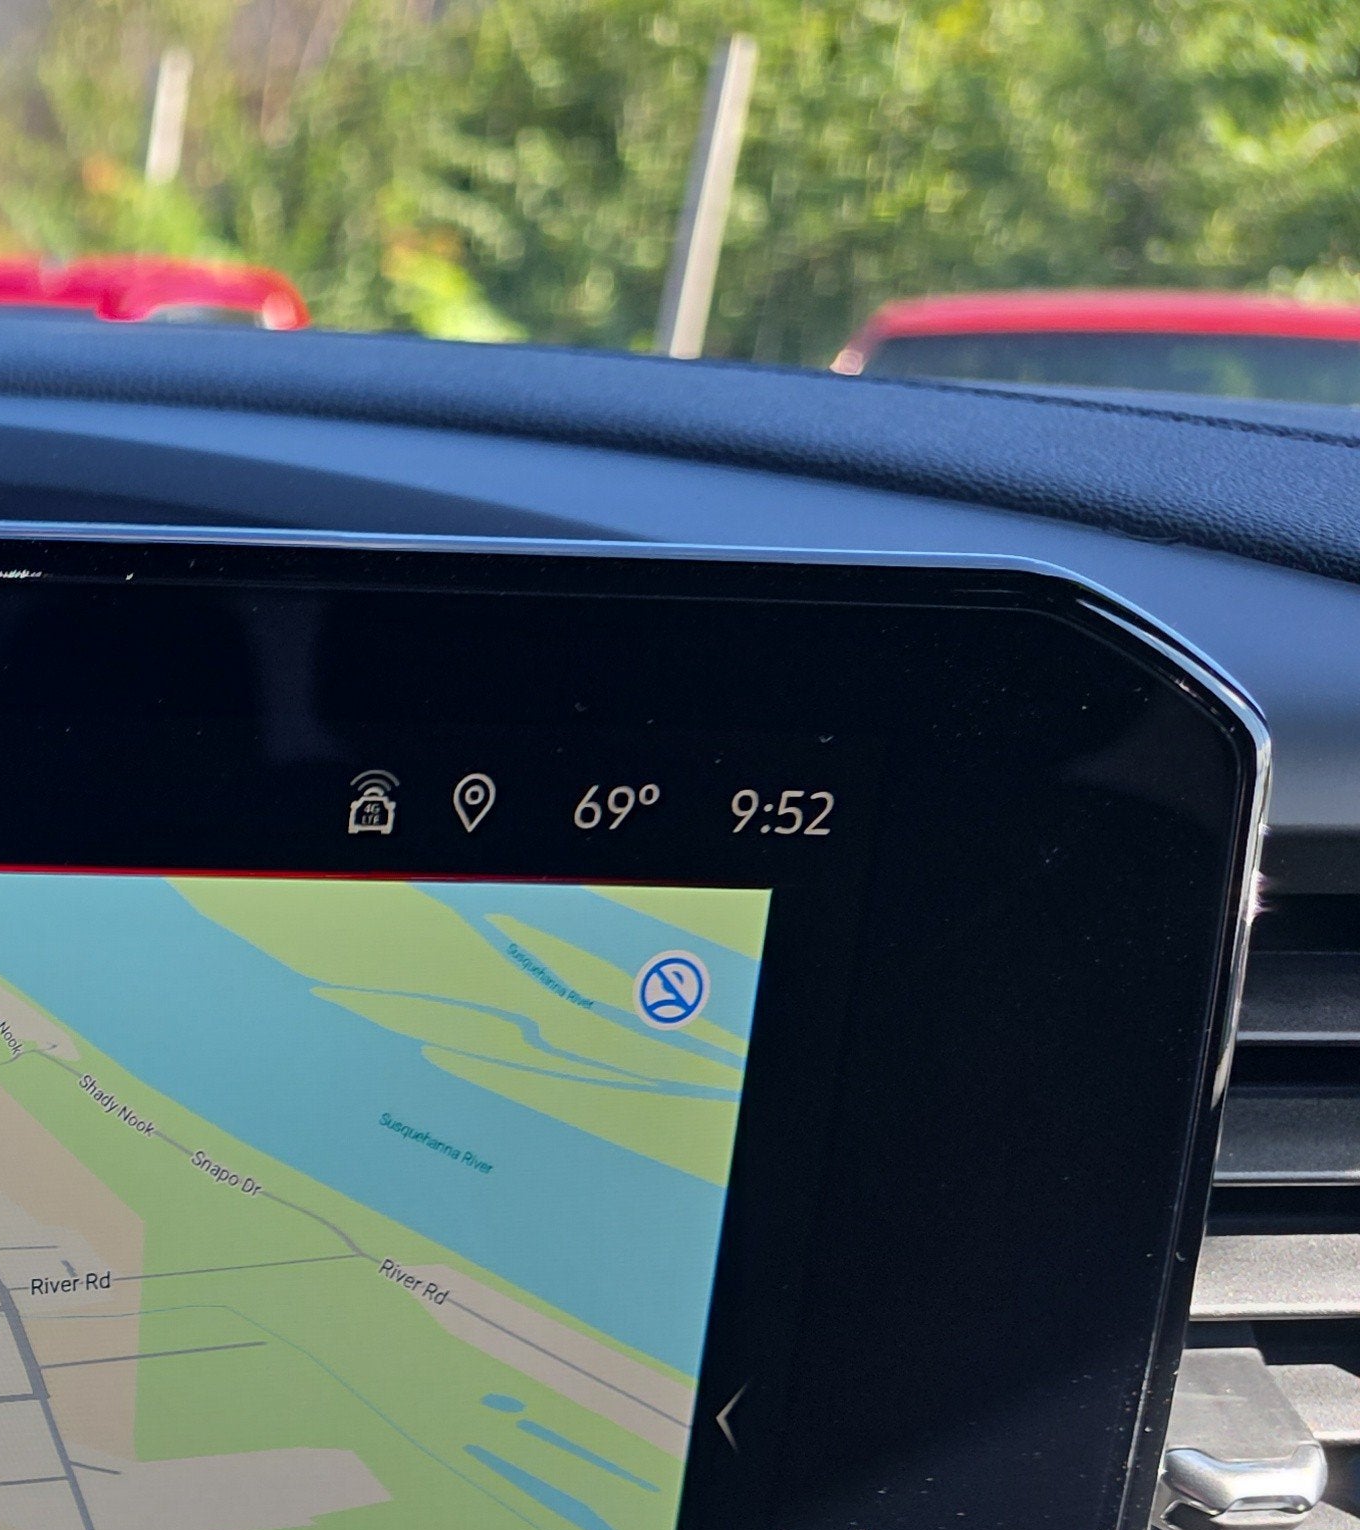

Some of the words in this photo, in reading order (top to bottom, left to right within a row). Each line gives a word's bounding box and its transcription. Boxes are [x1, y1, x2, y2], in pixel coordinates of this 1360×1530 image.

[731, 788, 835, 836] 9:52
[79, 1073, 118, 1114] Shady
[116, 1100, 156, 1138] Nook
[379, 1111, 461, 1162] Susquehanna
[461, 1149, 493, 1176] River
[190, 1151, 239, 1190] Snapo
[238, 1173, 263, 1199] Dr
[30, 1275, 79, 1296] River
[85, 1271, 111, 1292] Rd
[379, 1258, 418, 1290] River
[421, 1280, 450, 1306] Rd
